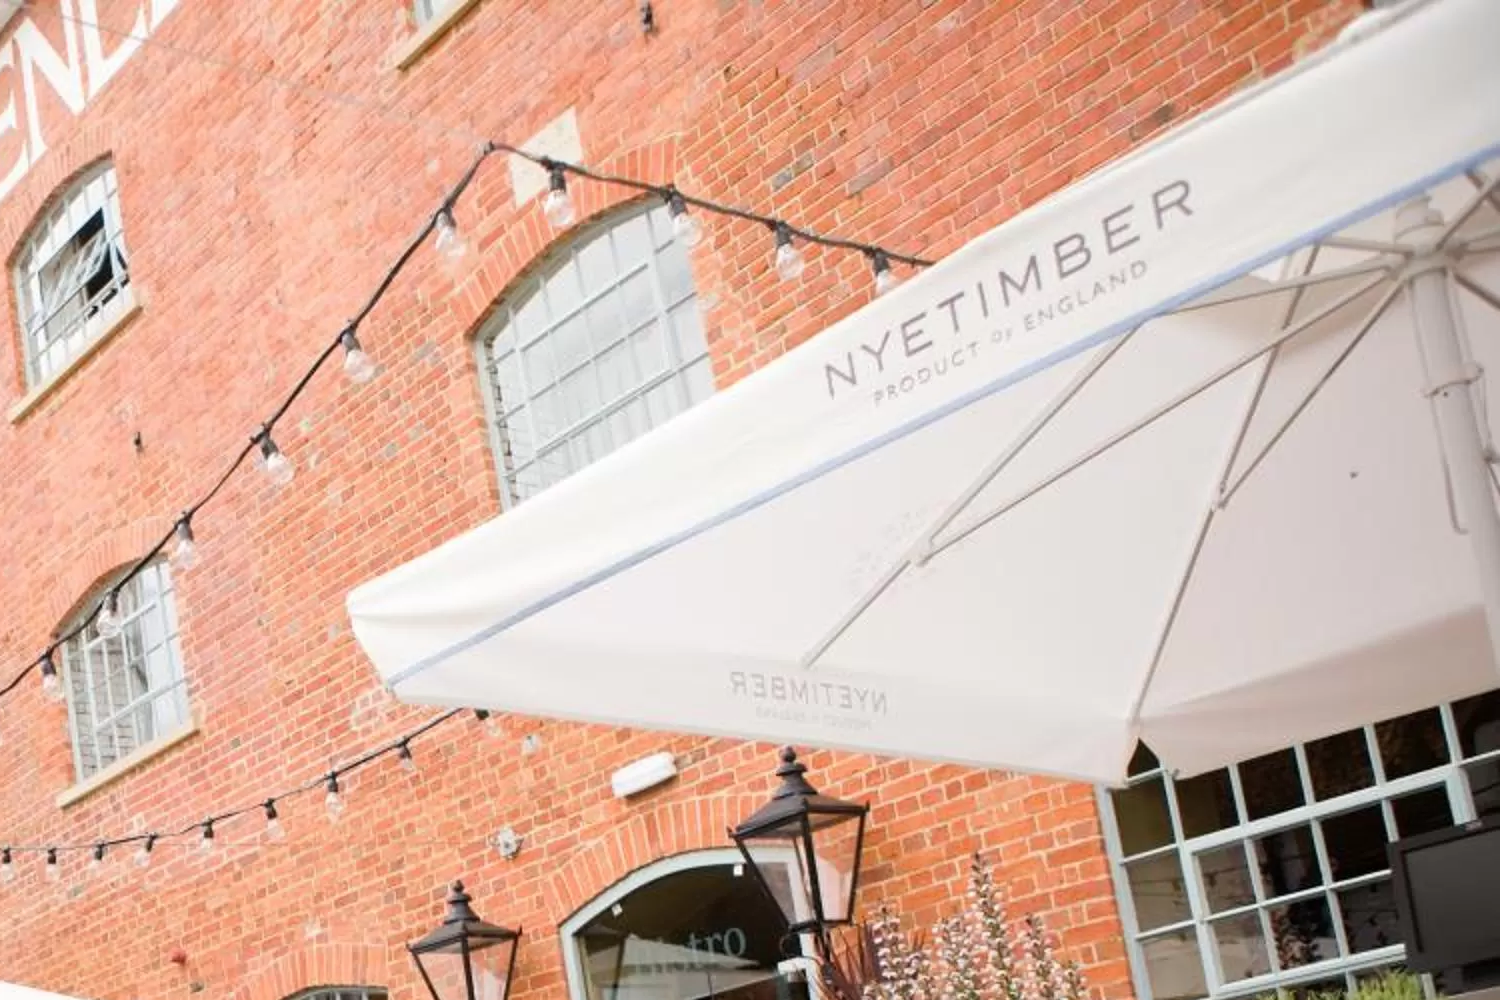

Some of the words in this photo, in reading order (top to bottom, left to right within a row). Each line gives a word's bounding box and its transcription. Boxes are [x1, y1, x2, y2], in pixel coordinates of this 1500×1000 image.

[823, 179, 1195, 397] NYETIMBER
[873, 342, 982, 407] PRODUCT
[1023, 259, 1149, 332] ENGLAND
